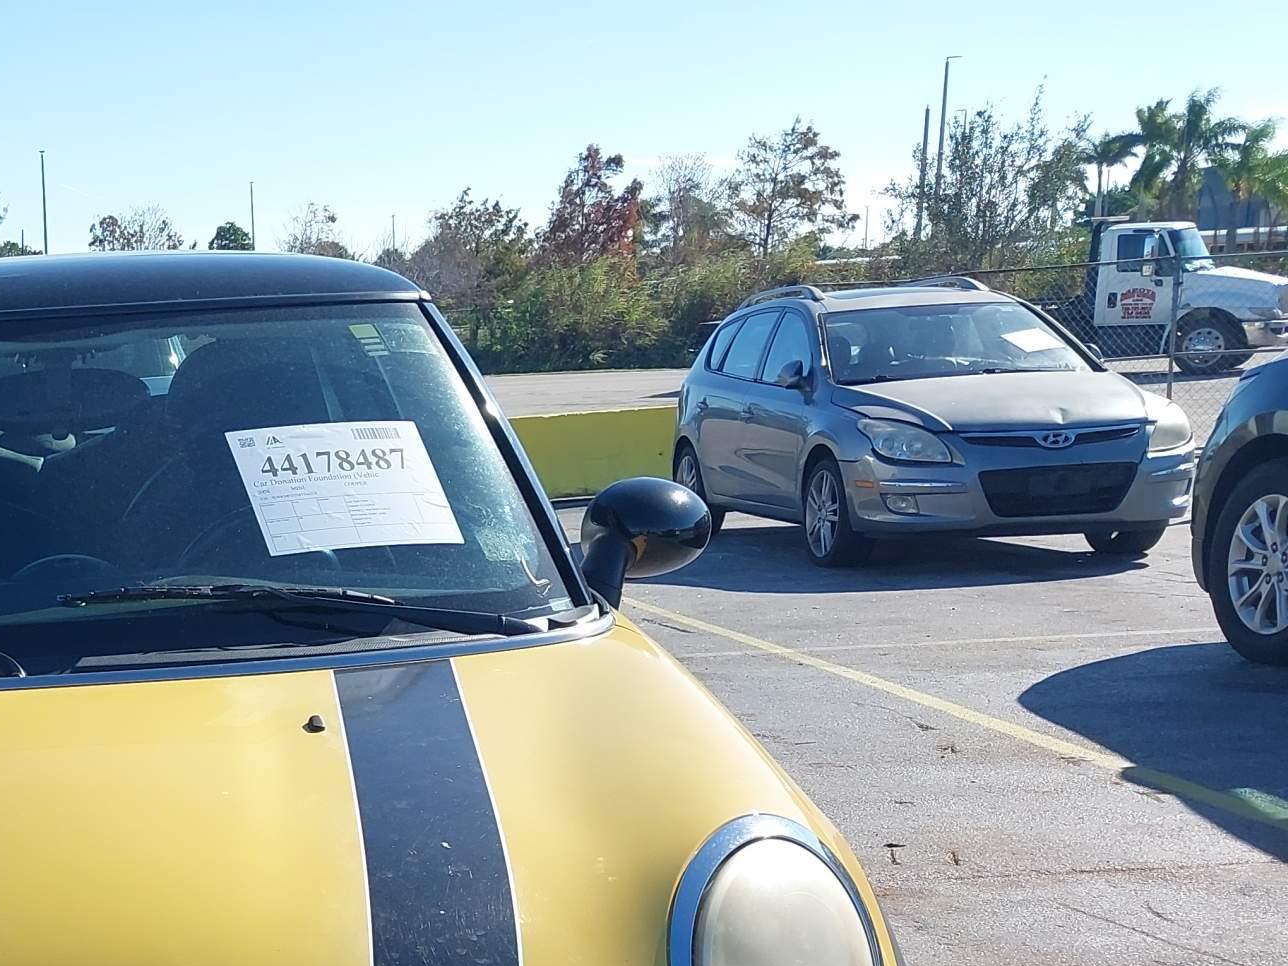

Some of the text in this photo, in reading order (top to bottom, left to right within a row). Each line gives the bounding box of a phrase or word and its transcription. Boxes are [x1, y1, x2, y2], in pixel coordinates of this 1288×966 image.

[260, 448, 406, 477] 44178487
[253, 471, 380, 488] Car Donation Foundation (Vehic
